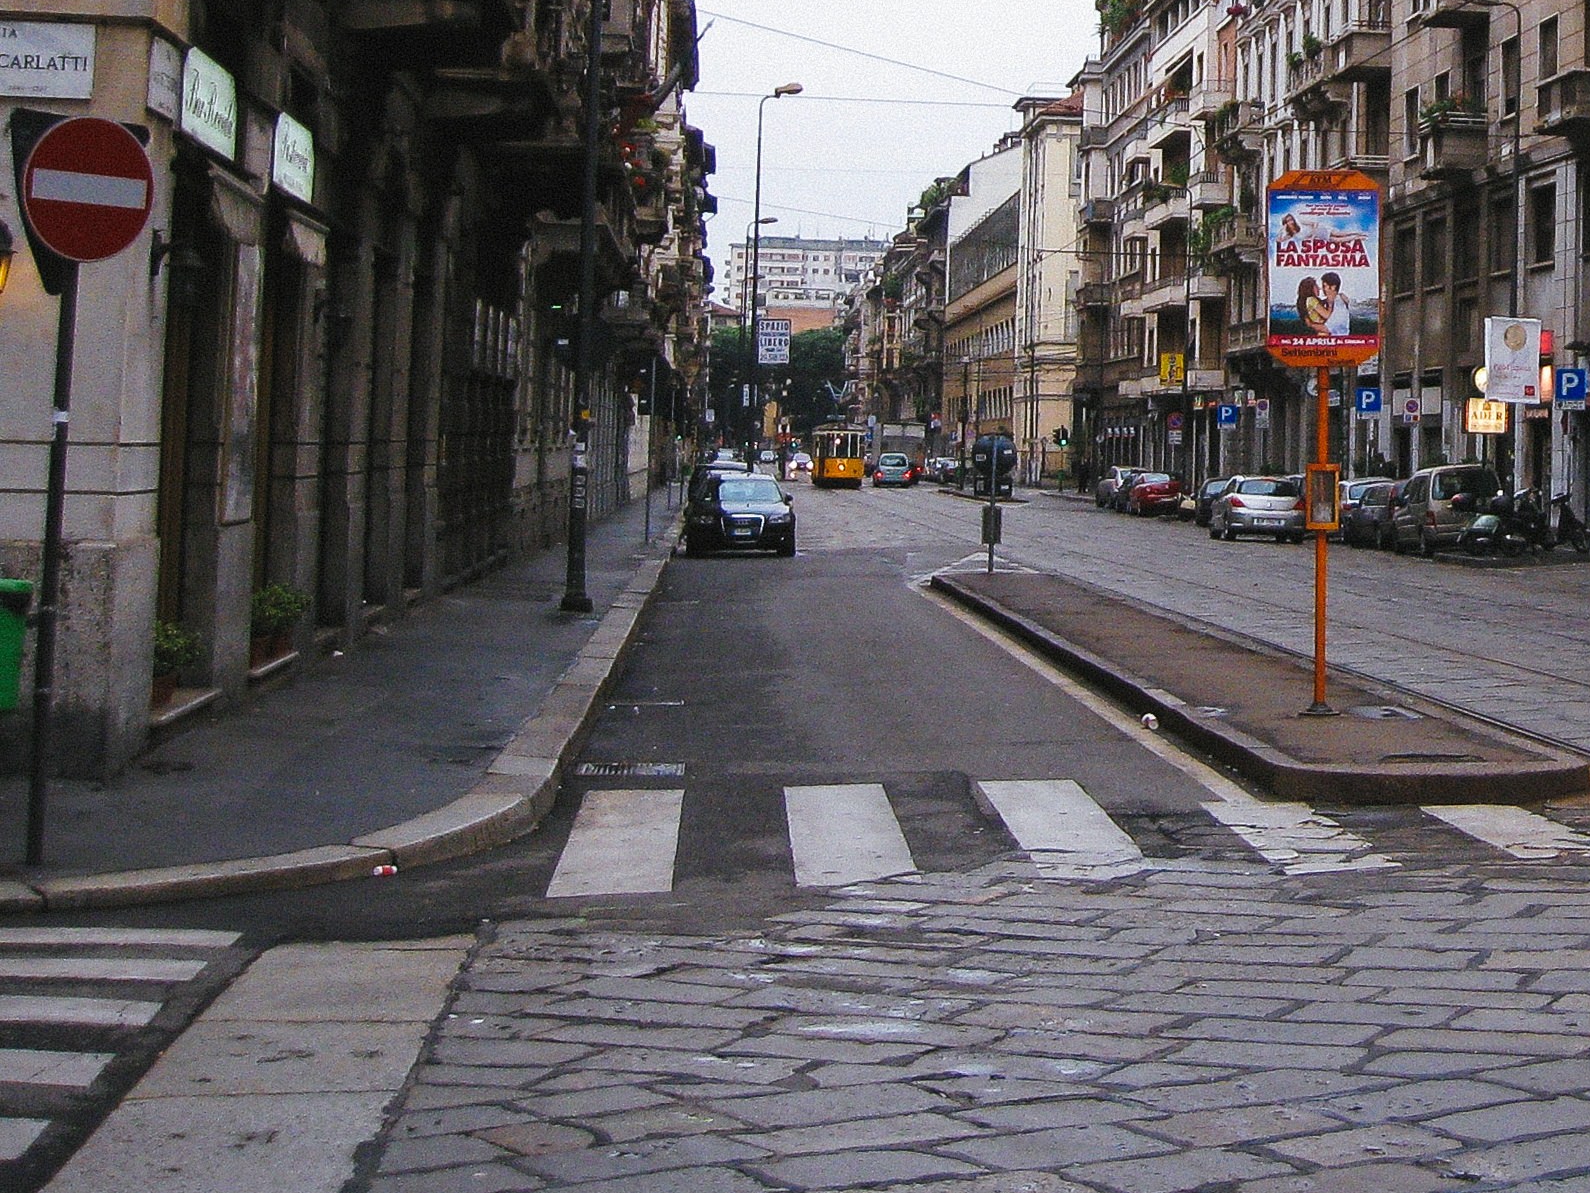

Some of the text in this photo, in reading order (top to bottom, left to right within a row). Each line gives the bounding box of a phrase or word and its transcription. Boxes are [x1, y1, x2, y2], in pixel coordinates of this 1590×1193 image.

[1276, 238, 1366, 254] LA SPOSA
[1275, 253, 1370, 267] FANTASMA
[760, 321, 789, 331] SPAZIO
[760, 338, 789, 347] LIBERO
[1292, 338, 1304, 346] 24
[1305, 338, 1337, 346] APRILE
[1562, 373, 1580, 396] P
[1362, 391, 1376, 409] P
[1221, 406, 1233, 421] P
